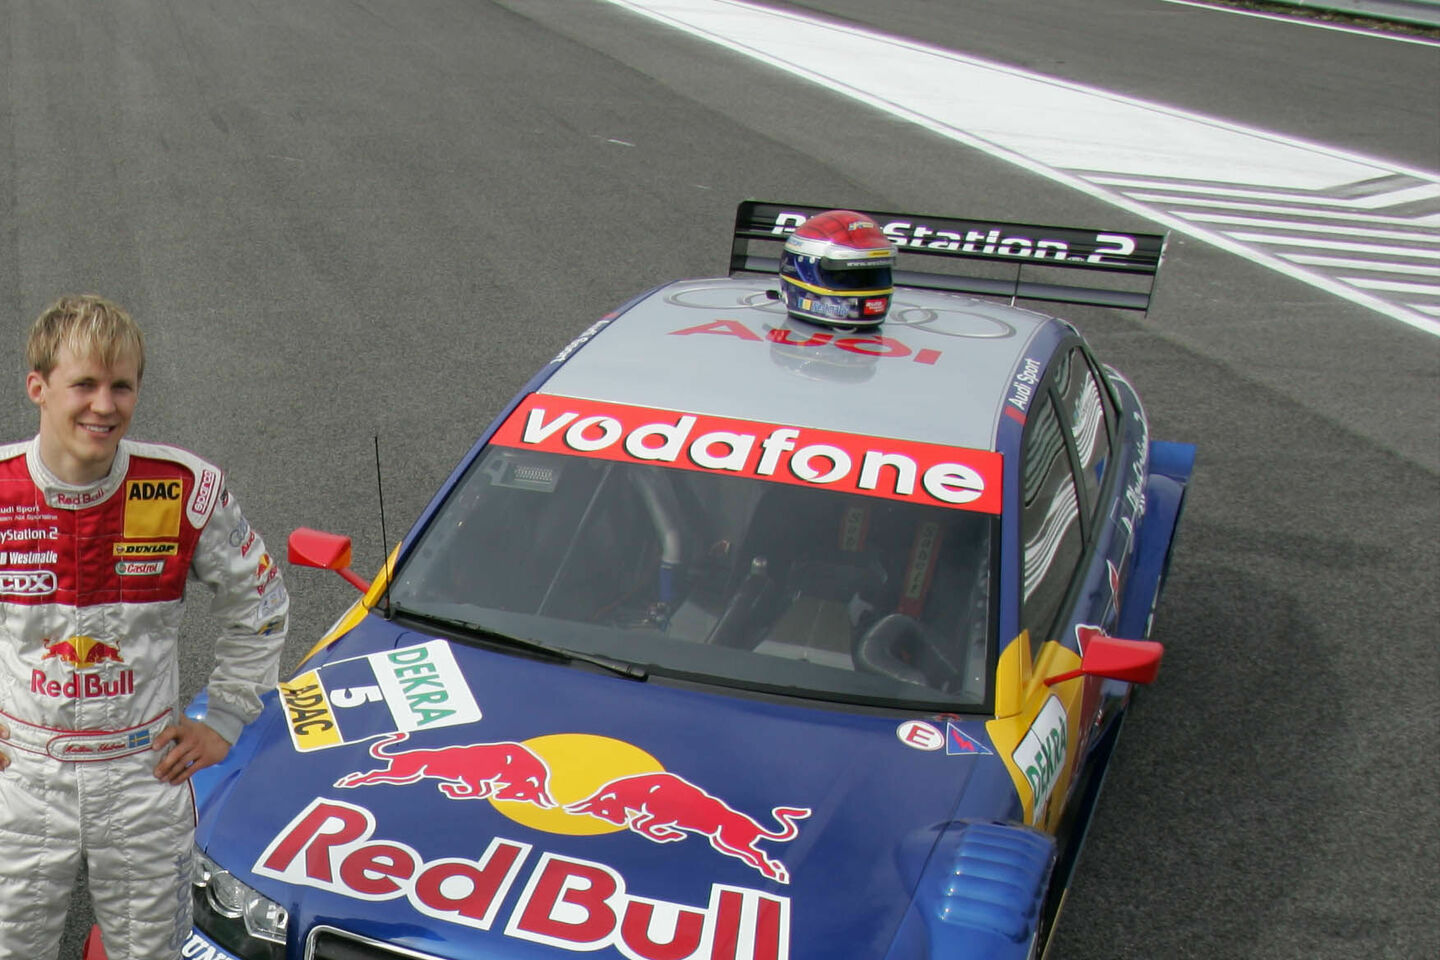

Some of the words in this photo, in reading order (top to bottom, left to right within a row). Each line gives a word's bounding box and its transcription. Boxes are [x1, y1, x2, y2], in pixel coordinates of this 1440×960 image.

[771, 212, 1069, 260] PStation
[1017, 358, 1040, 385] Sport
[1008, 382, 1032, 411] Audi
[522, 407, 986, 504] vodafone
[57, 493, 79, 505] Red
[82, 488, 105, 504] Bull
[128, 482, 180, 501] ADAC
[9, 550, 58, 565] Westmatic
[125, 545, 176, 554] DUNLOP
[126, 563, 159, 574] Castrol
[30, 668, 81, 698] Red
[83, 668, 134, 698] Bull
[329, 685, 384, 709] 5
[387, 646, 457, 727] DEKRA
[282, 683, 335, 736] ADAC
[257, 800, 528, 928] Red
